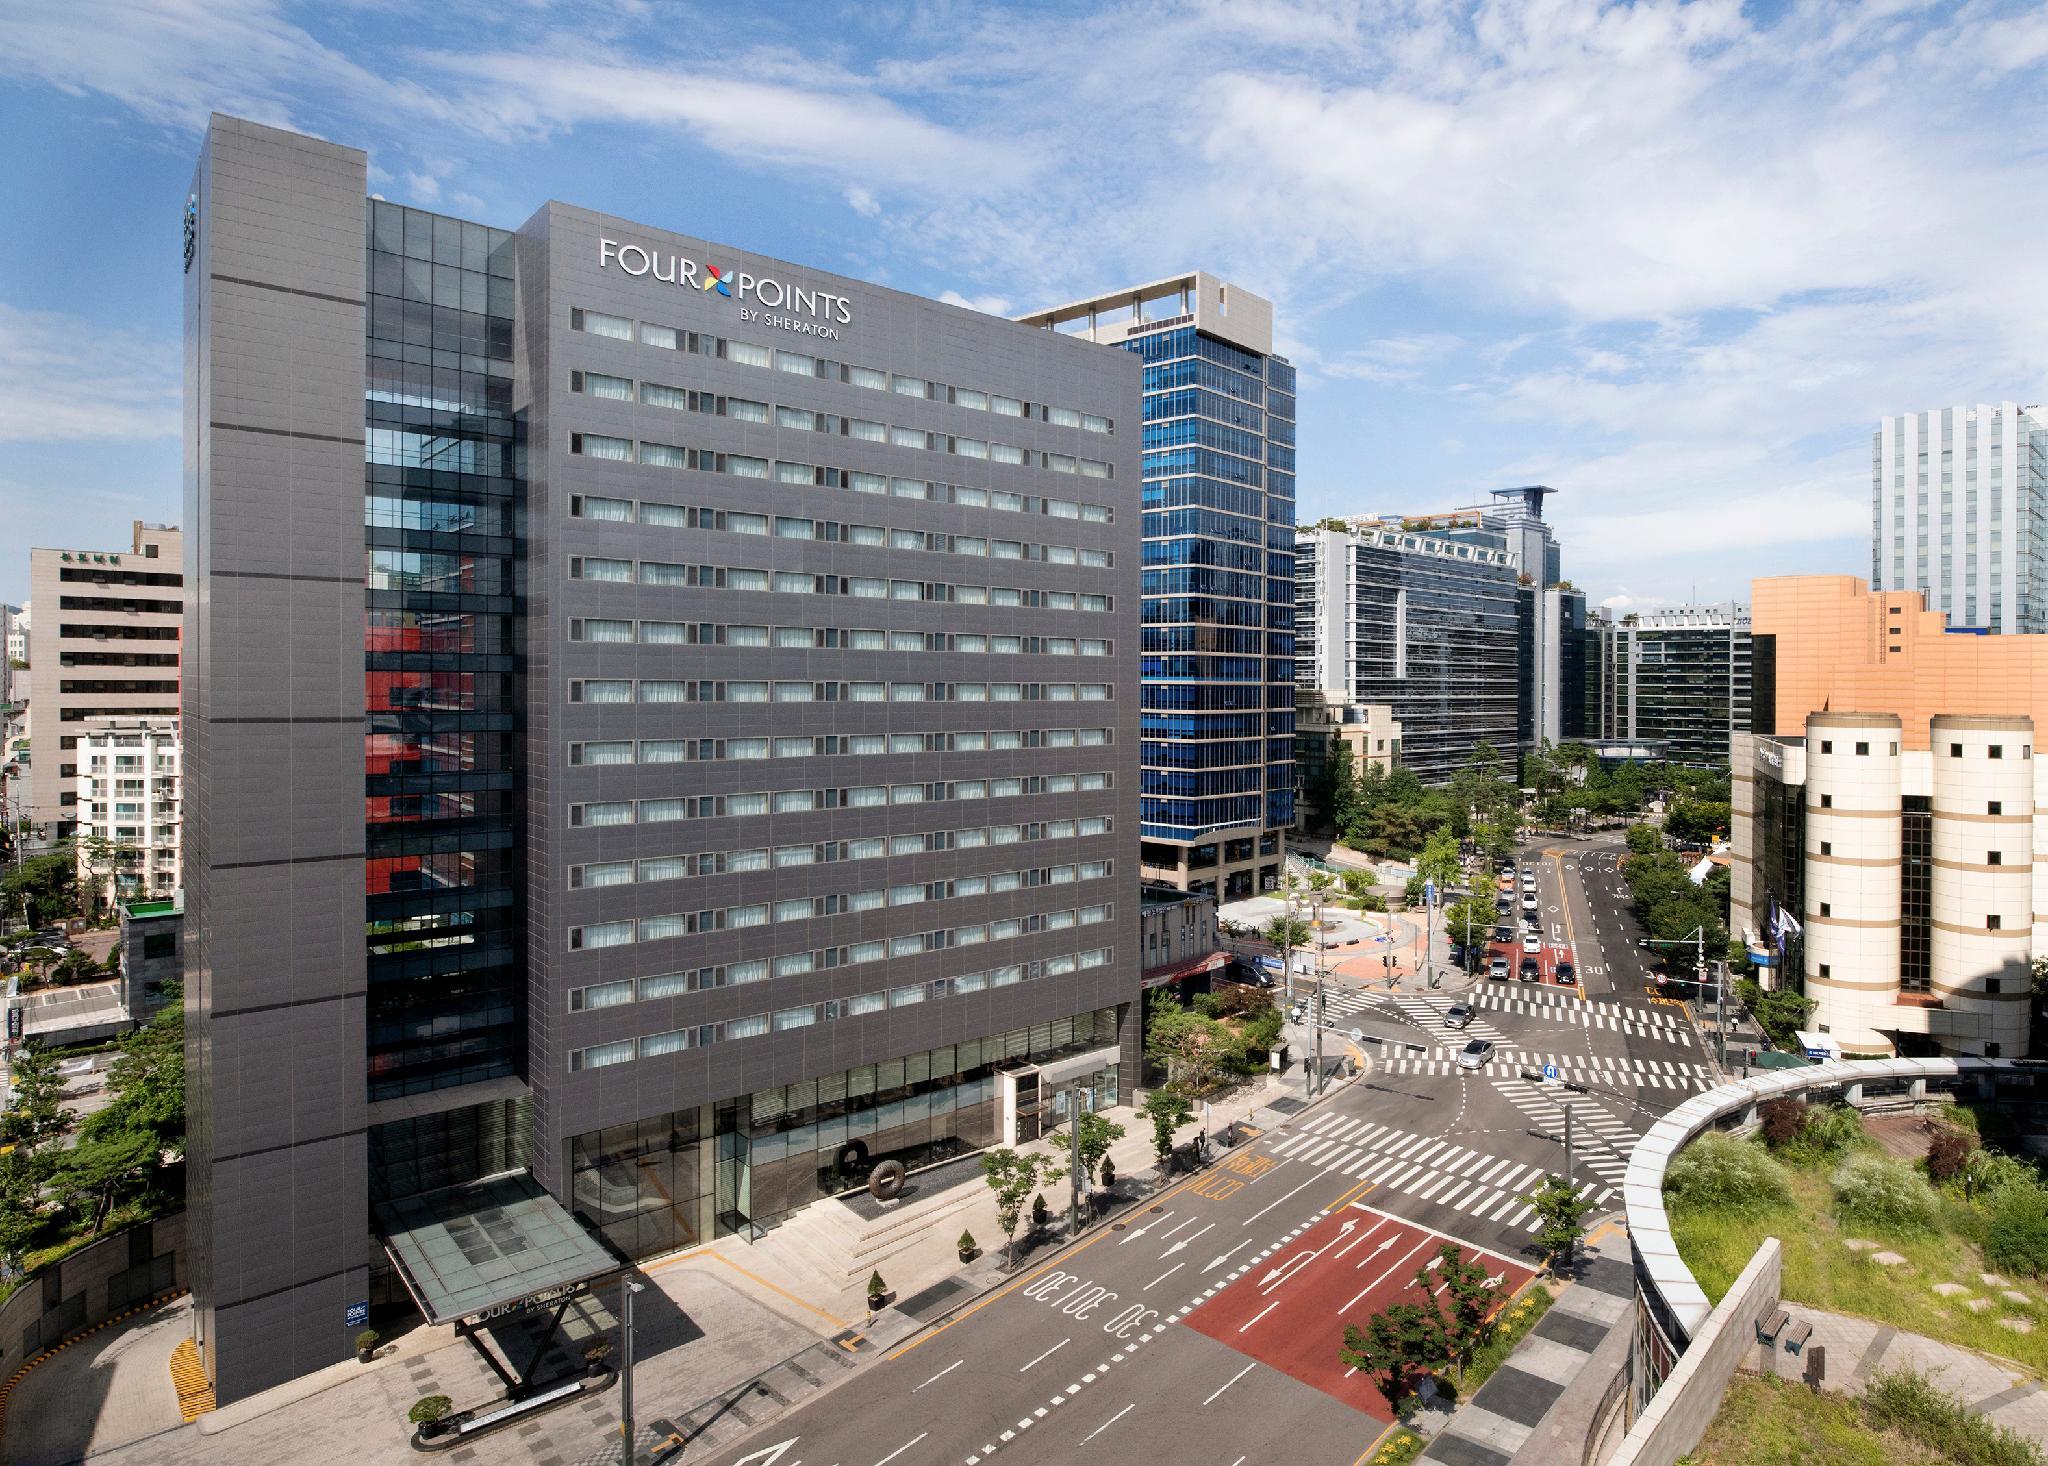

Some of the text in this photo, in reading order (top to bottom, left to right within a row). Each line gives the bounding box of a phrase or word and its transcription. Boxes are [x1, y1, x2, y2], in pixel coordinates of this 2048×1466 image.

[599, 238, 851, 324] FOUR POINTS
[740, 307, 839, 341] BY SHERATON
[1584, 965, 1603, 975] 30
[537, 1295, 572, 1311] SHERATON
